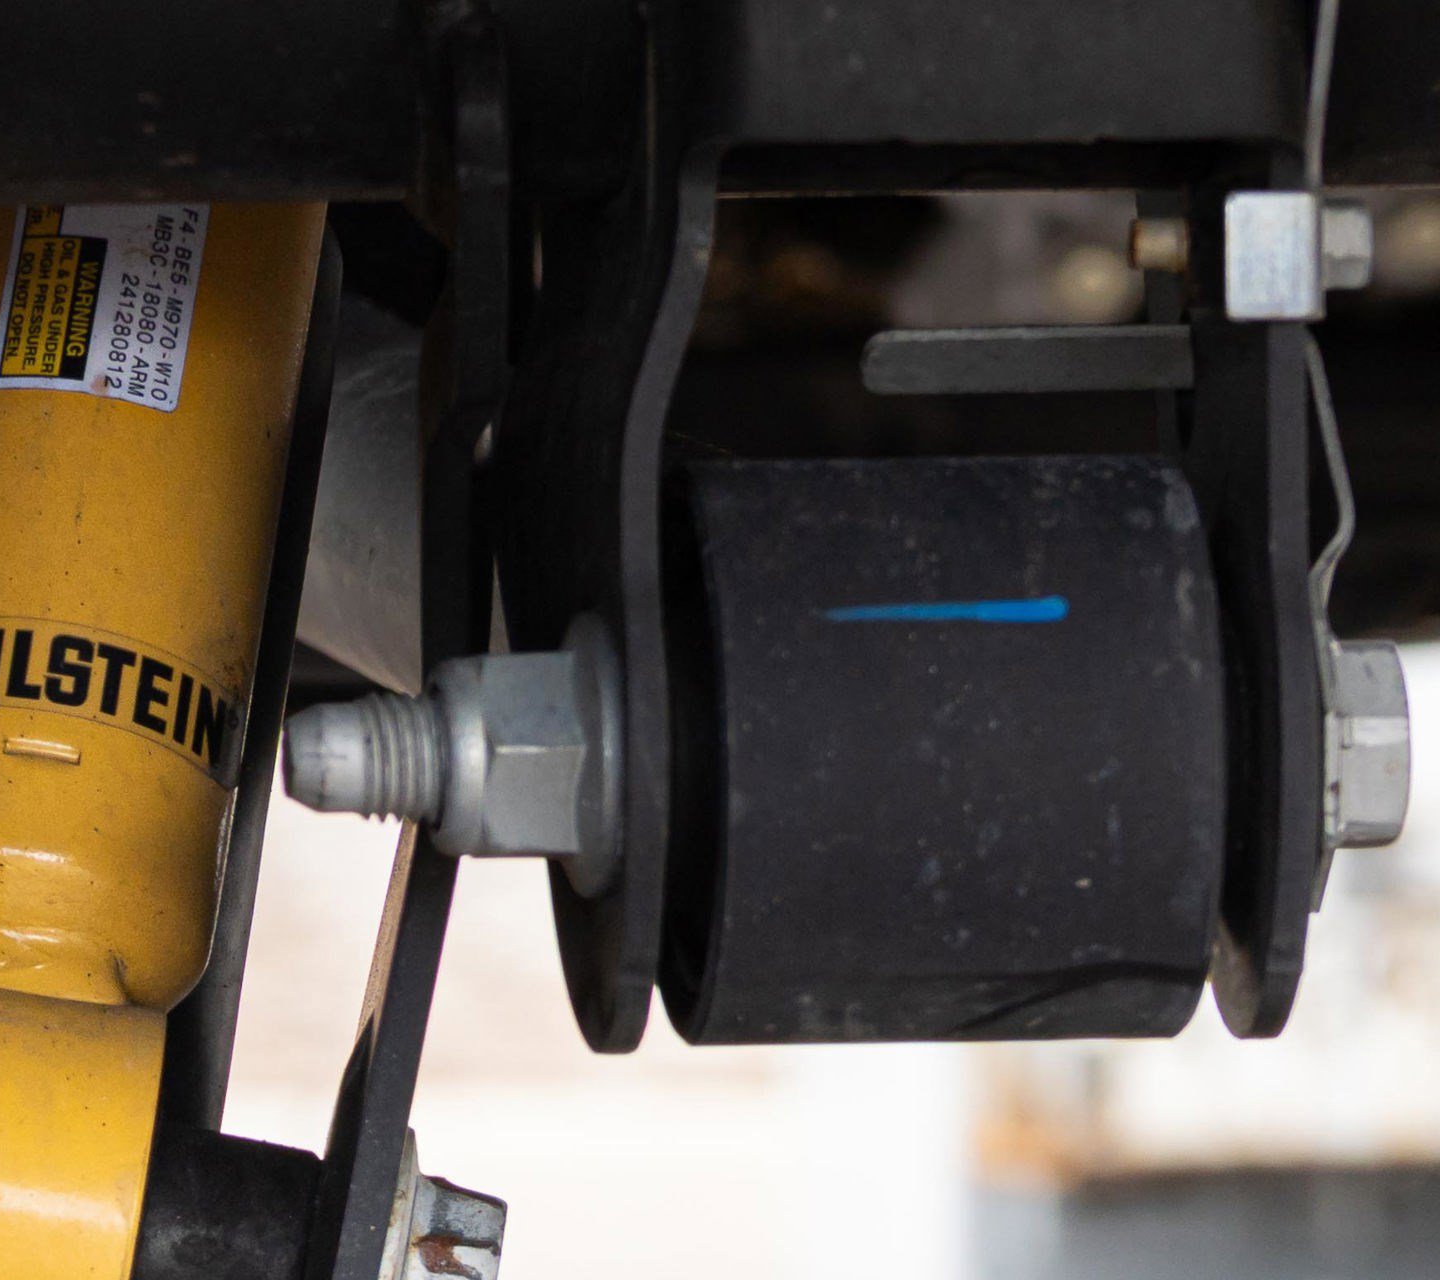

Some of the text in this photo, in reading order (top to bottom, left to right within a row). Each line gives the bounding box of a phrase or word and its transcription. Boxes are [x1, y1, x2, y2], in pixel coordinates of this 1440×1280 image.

[38, 241, 56, 279] HIGH
[59, 239, 76, 263] OIL
[5, 252, 35, 361] DO NOT OPEN.
[21, 283, 48, 370] PRESSURE.
[51, 283, 68, 315] GAS
[66, 261, 99, 357] WARNING
[104, 272, 139, 390] 241280812
[128, 215, 174, 398] MB3C-18080-ARM
[40, 320, 62, 373] UNDER
